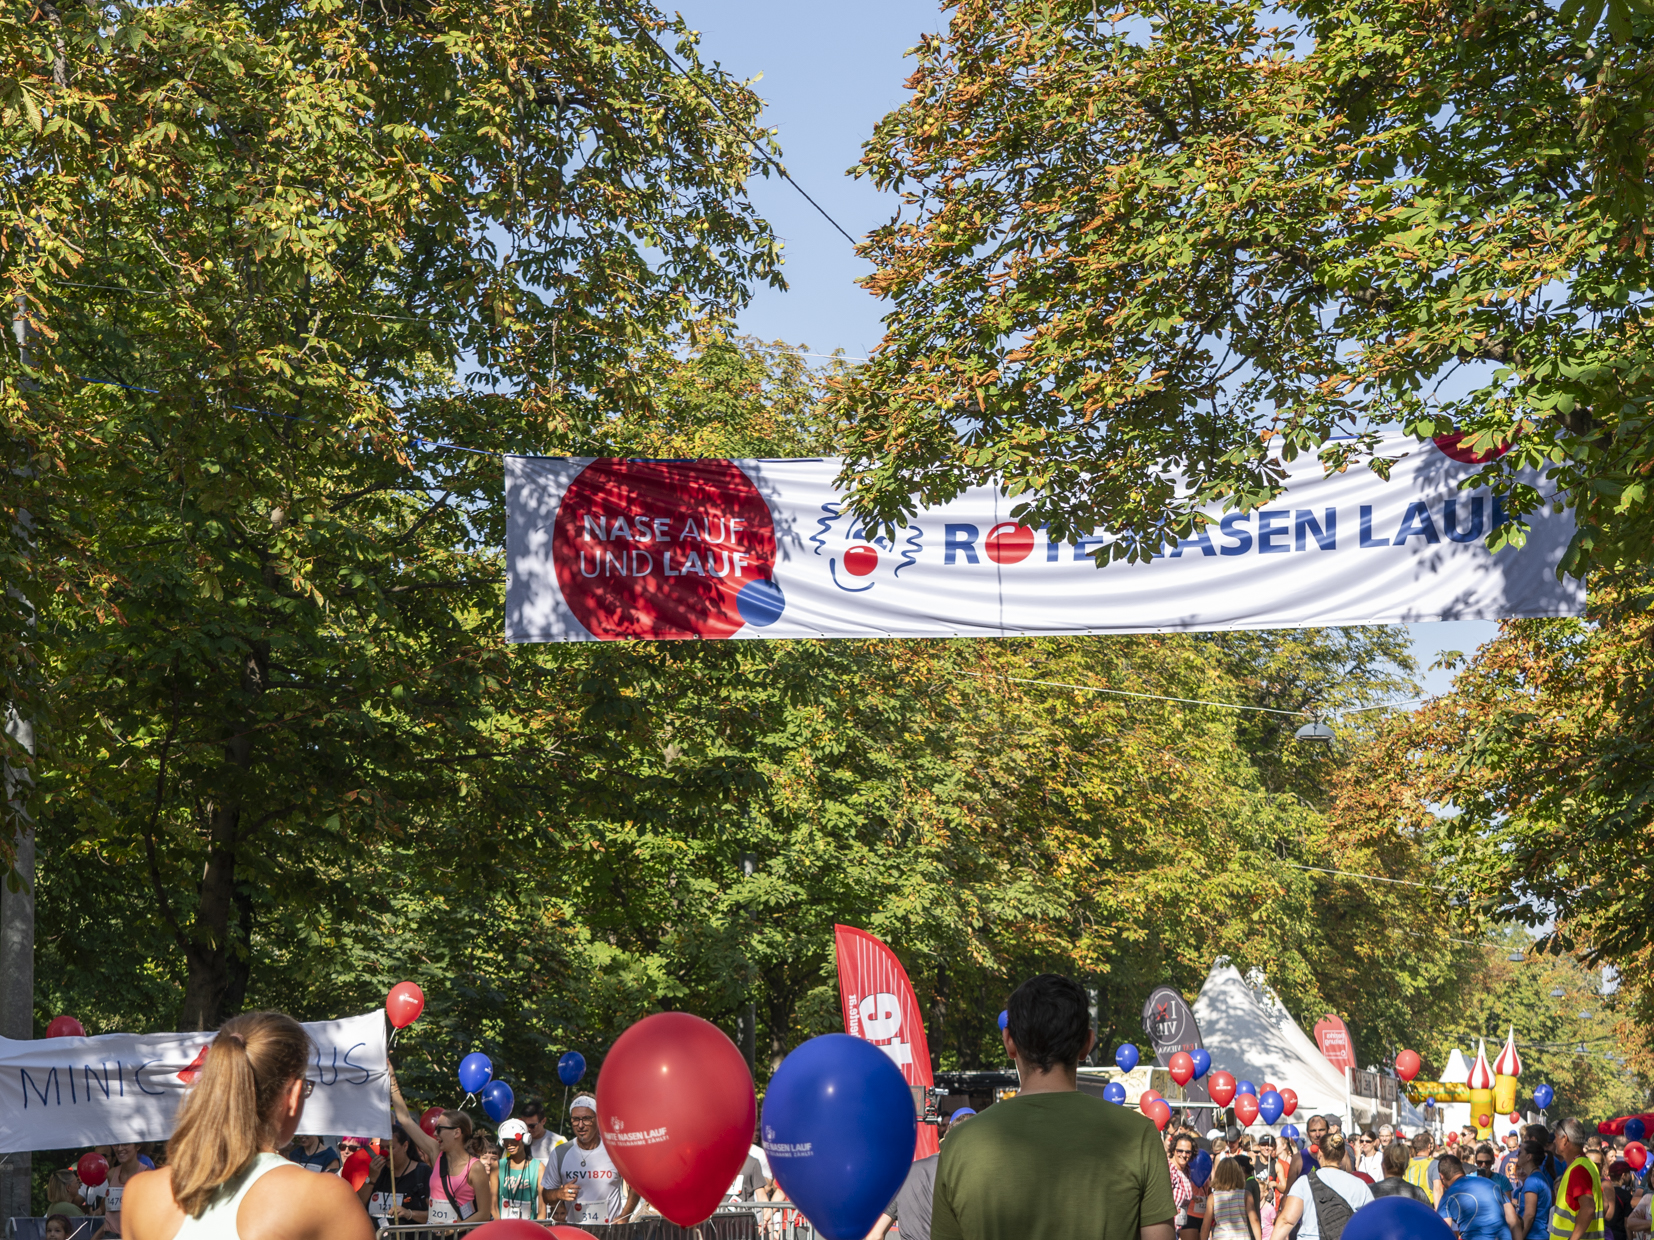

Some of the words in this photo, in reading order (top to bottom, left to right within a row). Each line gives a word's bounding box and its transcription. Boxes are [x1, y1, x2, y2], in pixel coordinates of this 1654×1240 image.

[583, 514, 671, 543] NASE
[679, 517, 746, 544] AUF
[1118, 506, 1338, 560] ASEN
[580, 550, 654, 578] UND
[663, 550, 750, 578] LAUF
[617, 1131, 644, 1141] NASEN
[643, 1127, 667, 1139] LAUF
[790, 1142, 812, 1151] LAUF
[565, 1170, 613, 1180] KSV1870
[432, 1210, 448, 1219] 201
[582, 1212, 599, 1222] 314
